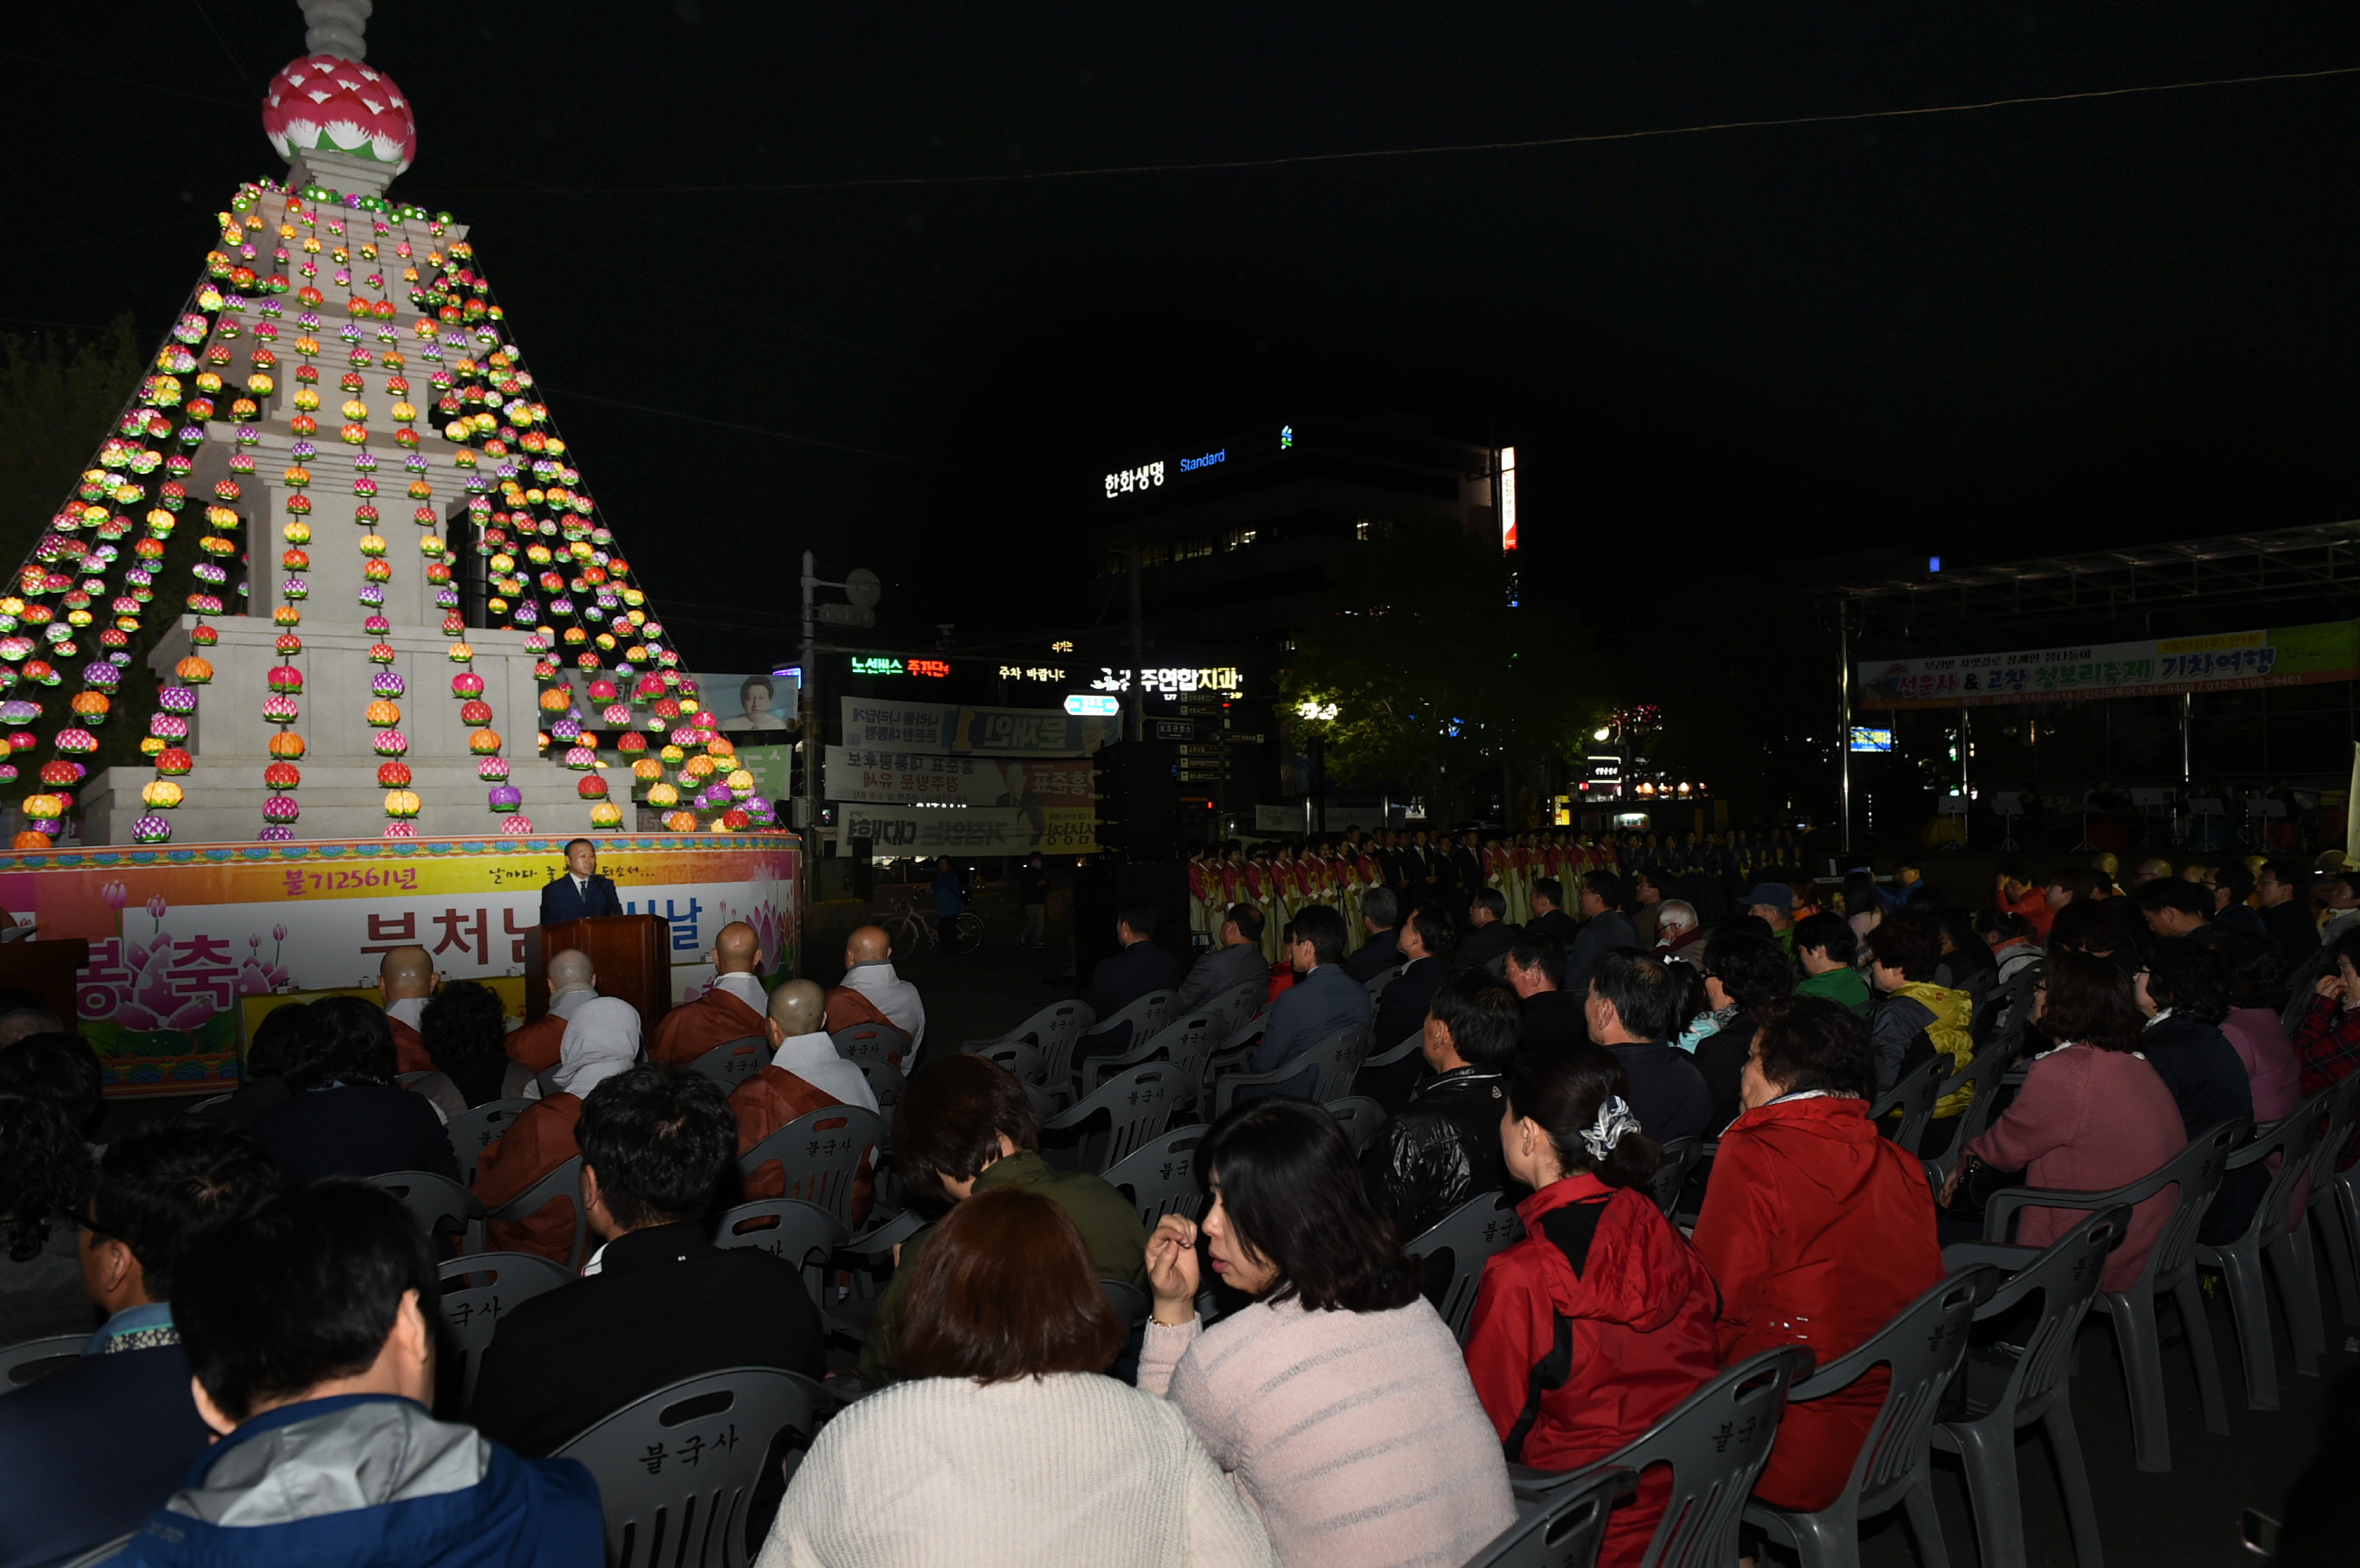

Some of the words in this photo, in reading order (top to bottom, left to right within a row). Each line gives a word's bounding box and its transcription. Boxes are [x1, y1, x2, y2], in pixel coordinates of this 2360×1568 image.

[1180, 448, 1225, 472] Standard
[1105, 461, 1164, 498] 한화생명
[999, 665, 1021, 680] 주차
[1898, 673, 1956, 697] 선운사
[1964, 674, 1979, 690] &
[1987, 668, 2028, 690] 고창
[2036, 659, 2152, 688] 청보리축제
[2162, 649, 2275, 676] 기차여행
[2024, 690, 2073, 702] 743-4114
[2140, 683, 2195, 696] 744-9400
[2206, 675, 2301, 690] 010-3198-9401
[282, 868, 418, 896] 불기2561년
[489, 867, 538, 884] 날마다
[77, 934, 239, 1018] 봉축
[847, 1044, 879, 1056] 불국사
[725, 1059, 758, 1072] 불국사
[1128, 1089, 1163, 1105] 불국사
[806, 1139, 852, 1157] 불국사
[1160, 1160, 1190, 1180] 불국
[449, 1296, 502, 1327] 국사
[639, 1425, 739, 1474] 불국사
